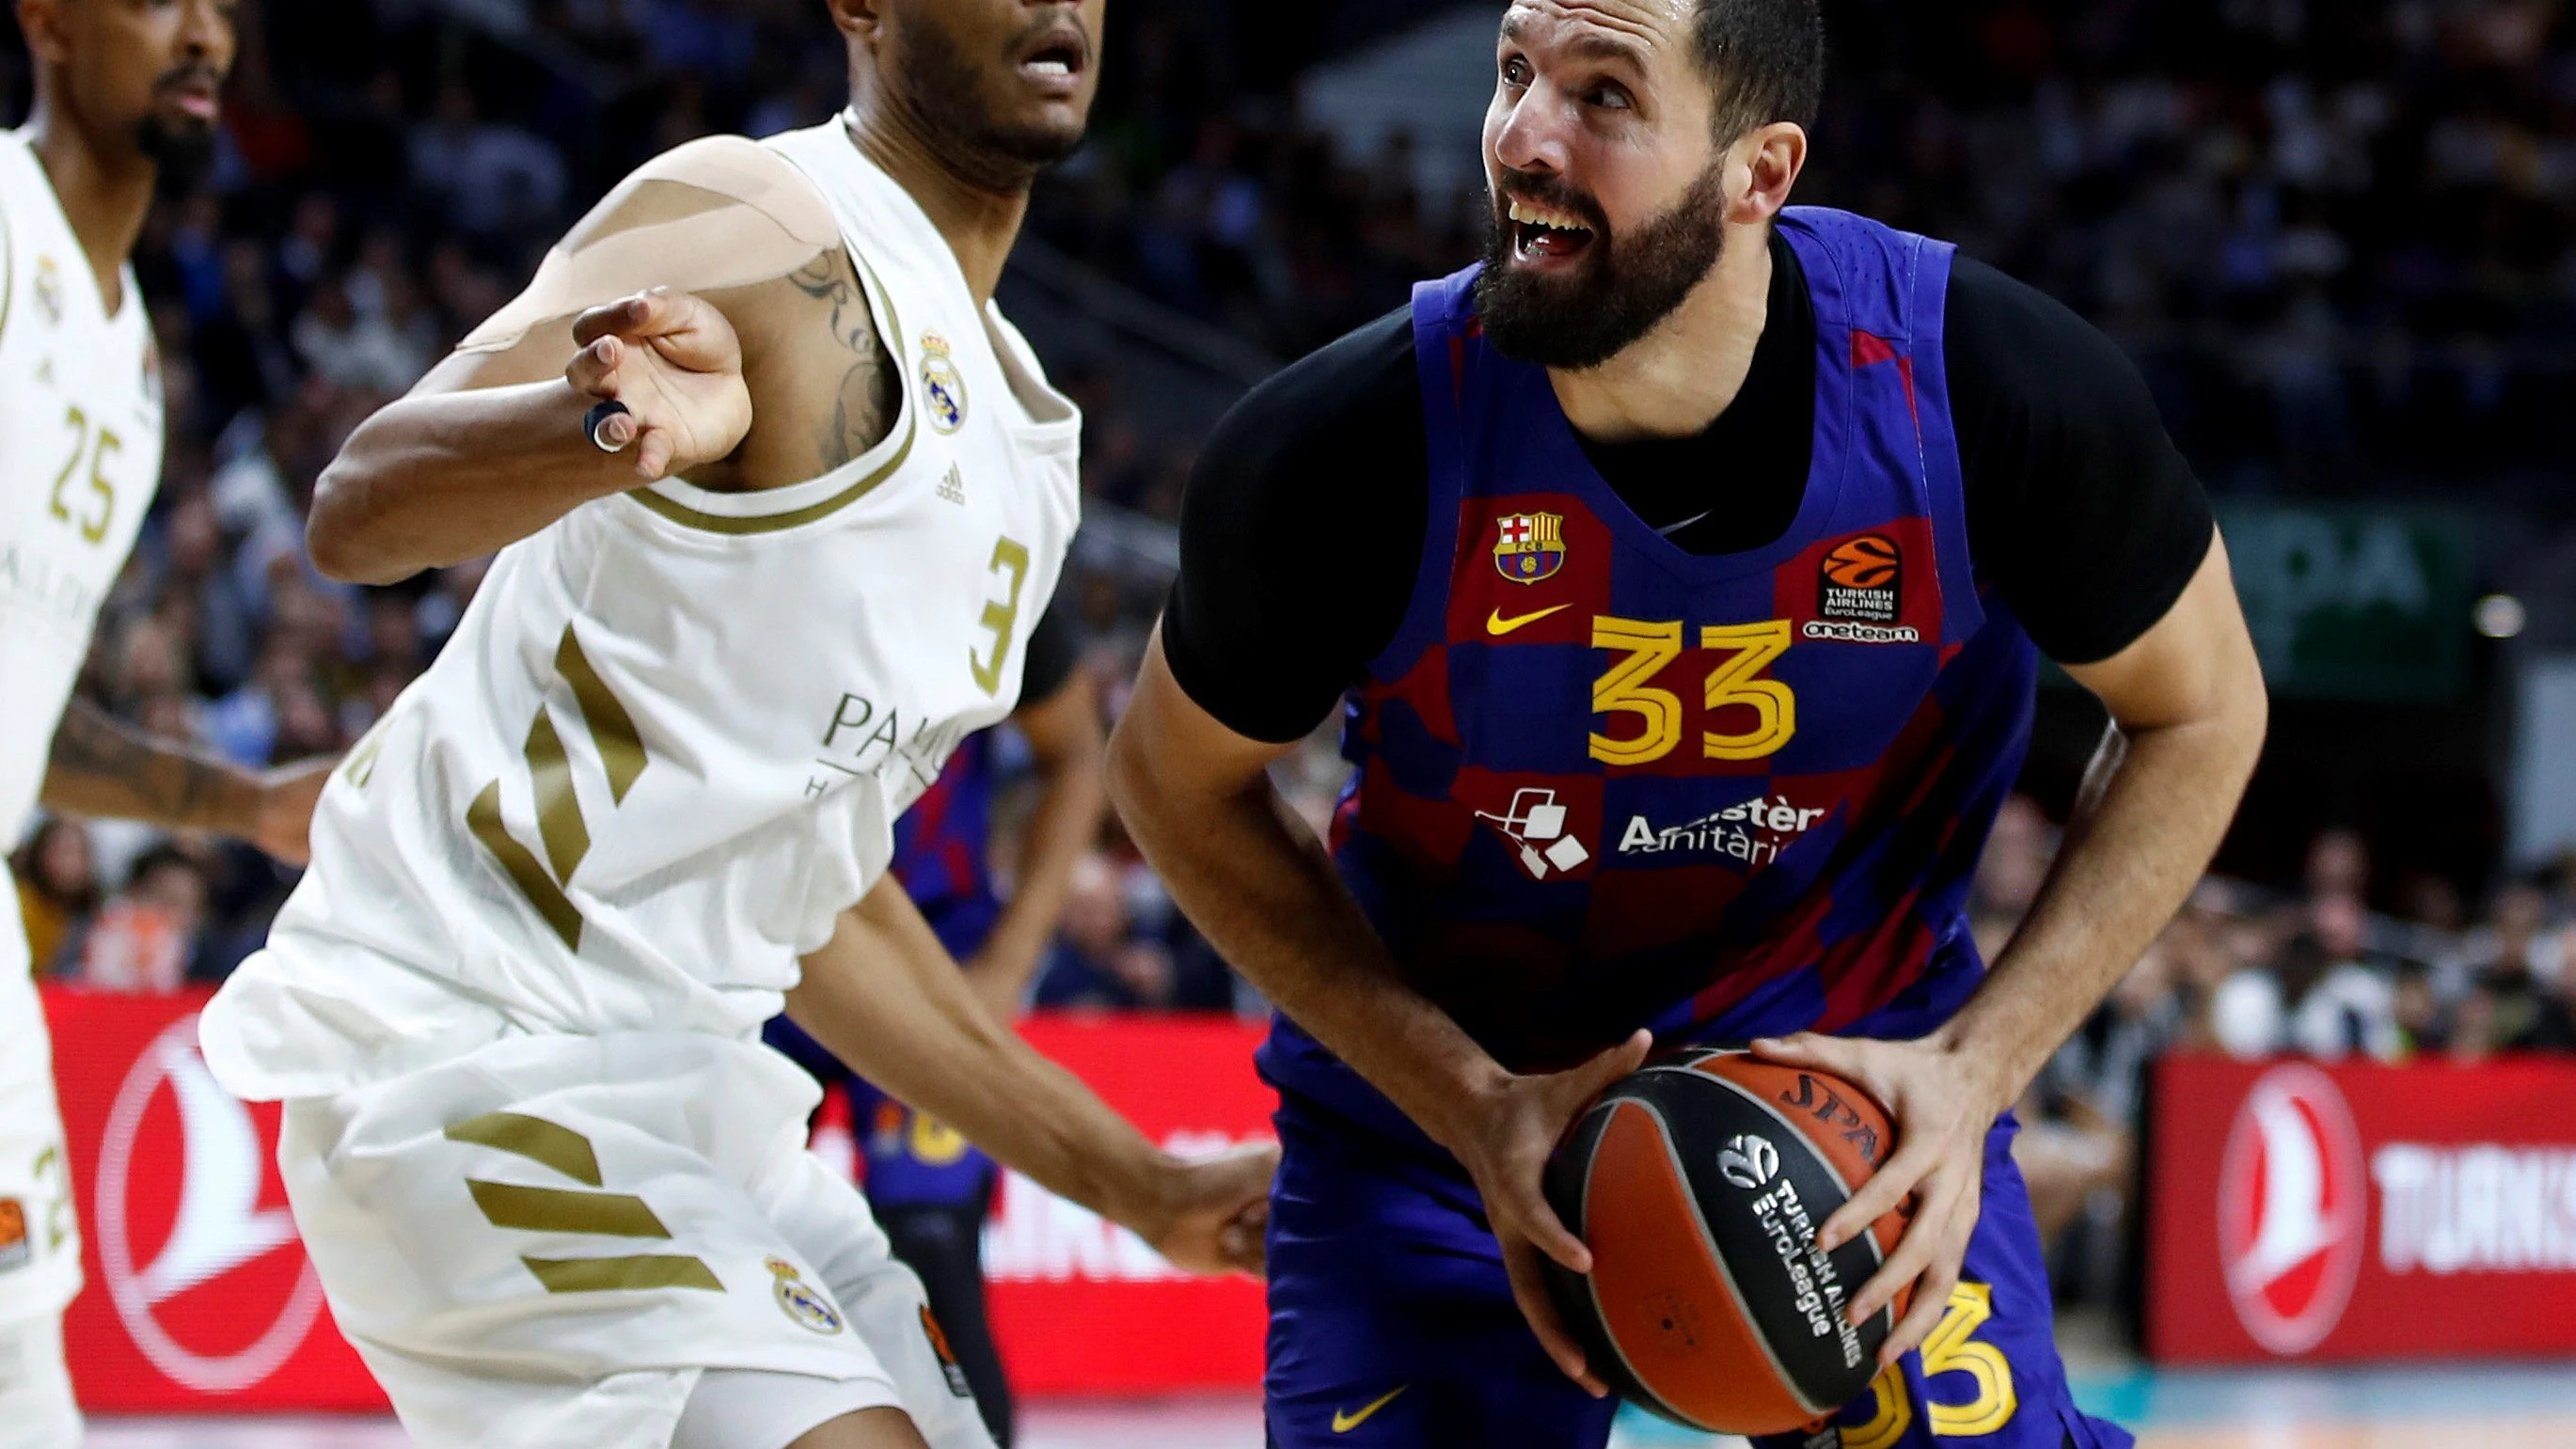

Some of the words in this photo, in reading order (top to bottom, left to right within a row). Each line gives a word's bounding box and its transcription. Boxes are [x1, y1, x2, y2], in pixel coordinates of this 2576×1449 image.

[49, 404, 121, 545] 25
[969, 533, 1030, 699] 3
[1803, 621, 1919, 642] oneteam
[1825, 588, 1894, 602] TURKISH
[1825, 598, 1893, 611] AIRLINES
[1825, 606, 1893, 621] EuroLeague
[1588, 614, 1797, 766] 33
[1779, 1074, 1880, 1170] SPA
[1752, 1193, 1831, 1337] EuroLeague
